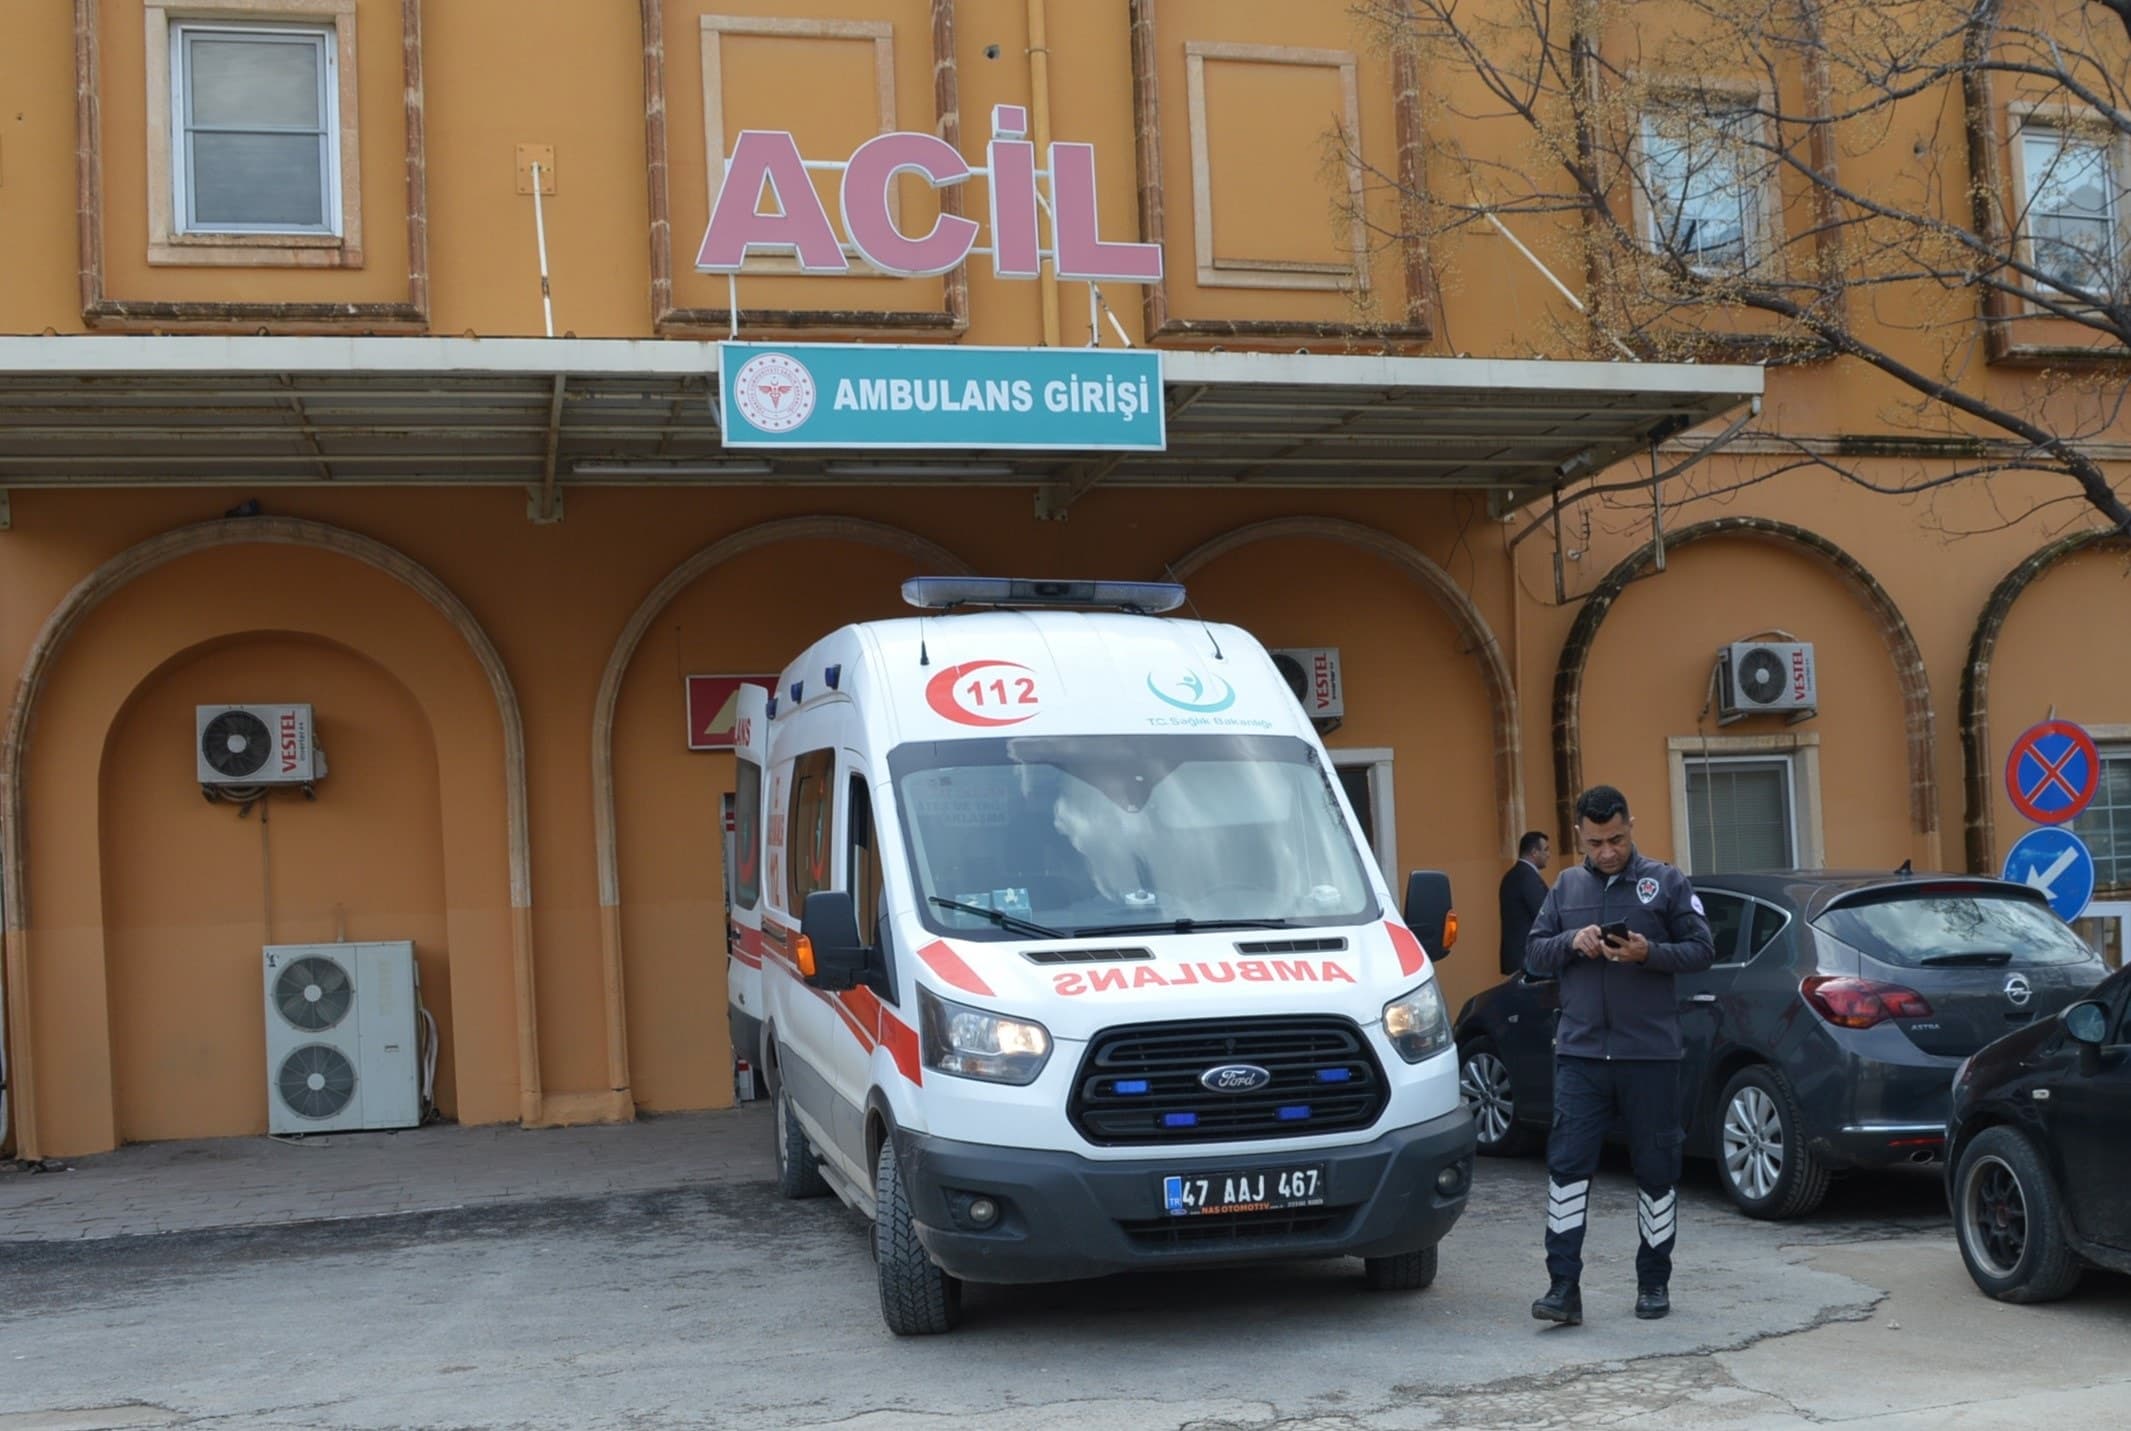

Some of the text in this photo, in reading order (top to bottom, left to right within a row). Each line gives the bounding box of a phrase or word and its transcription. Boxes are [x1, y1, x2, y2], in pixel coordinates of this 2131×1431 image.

[695, 104, 1163, 281] ACİL
[833, 378, 1033, 411] AMBULANS
[1044, 373, 1149, 421] GİRİŞİ
[967, 677, 1039, 706] 112
[1314, 652, 1329, 709] VESTEL
[1792, 648, 1805, 700] VESTEL
[280, 709, 296, 772] VESTEL
[1911, 1023, 1941, 1031] ASTRA
[1218, 1069, 1256, 1088] Ford
[1169, 1197, 1181, 1207] TR
[1182, 1169, 1318, 1207] 47 AAJ 467
[1202, 1205, 1220, 1215] NAS
